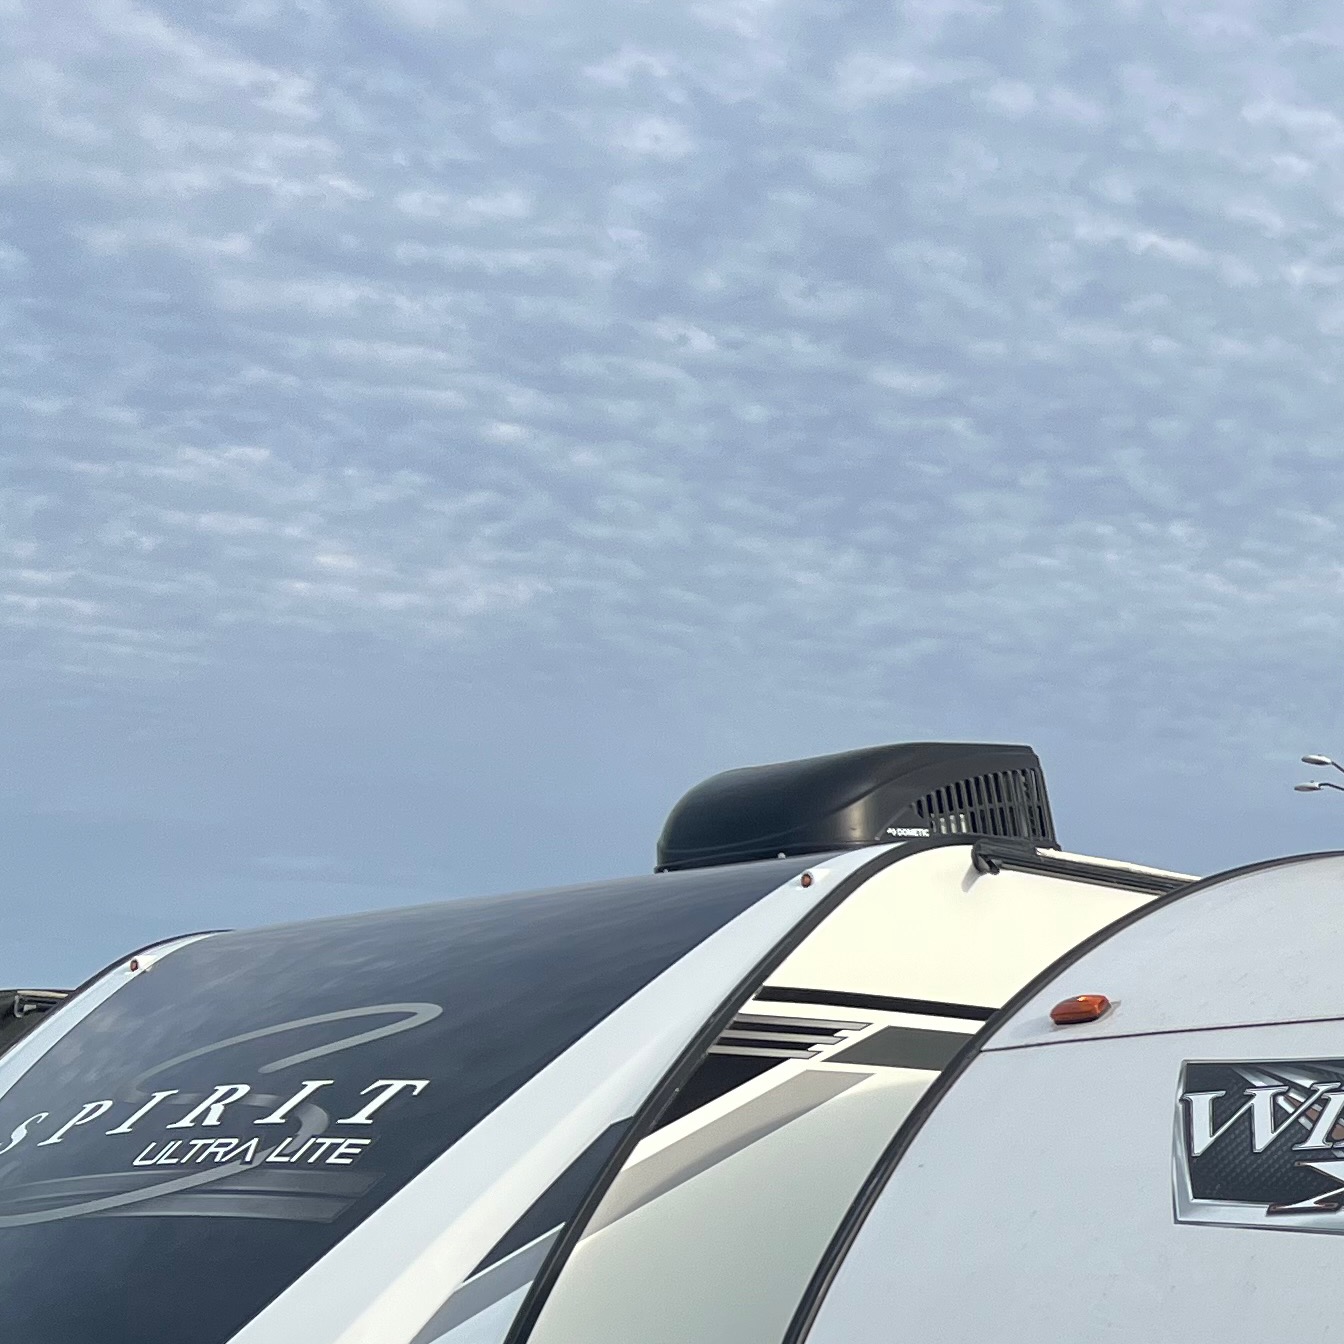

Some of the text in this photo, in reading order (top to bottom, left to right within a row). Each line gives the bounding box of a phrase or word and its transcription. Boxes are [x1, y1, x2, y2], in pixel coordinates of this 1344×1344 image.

[0, 1079, 430, 1155] SPIRIT
[132, 1137, 371, 1167] ULTRA LITE
